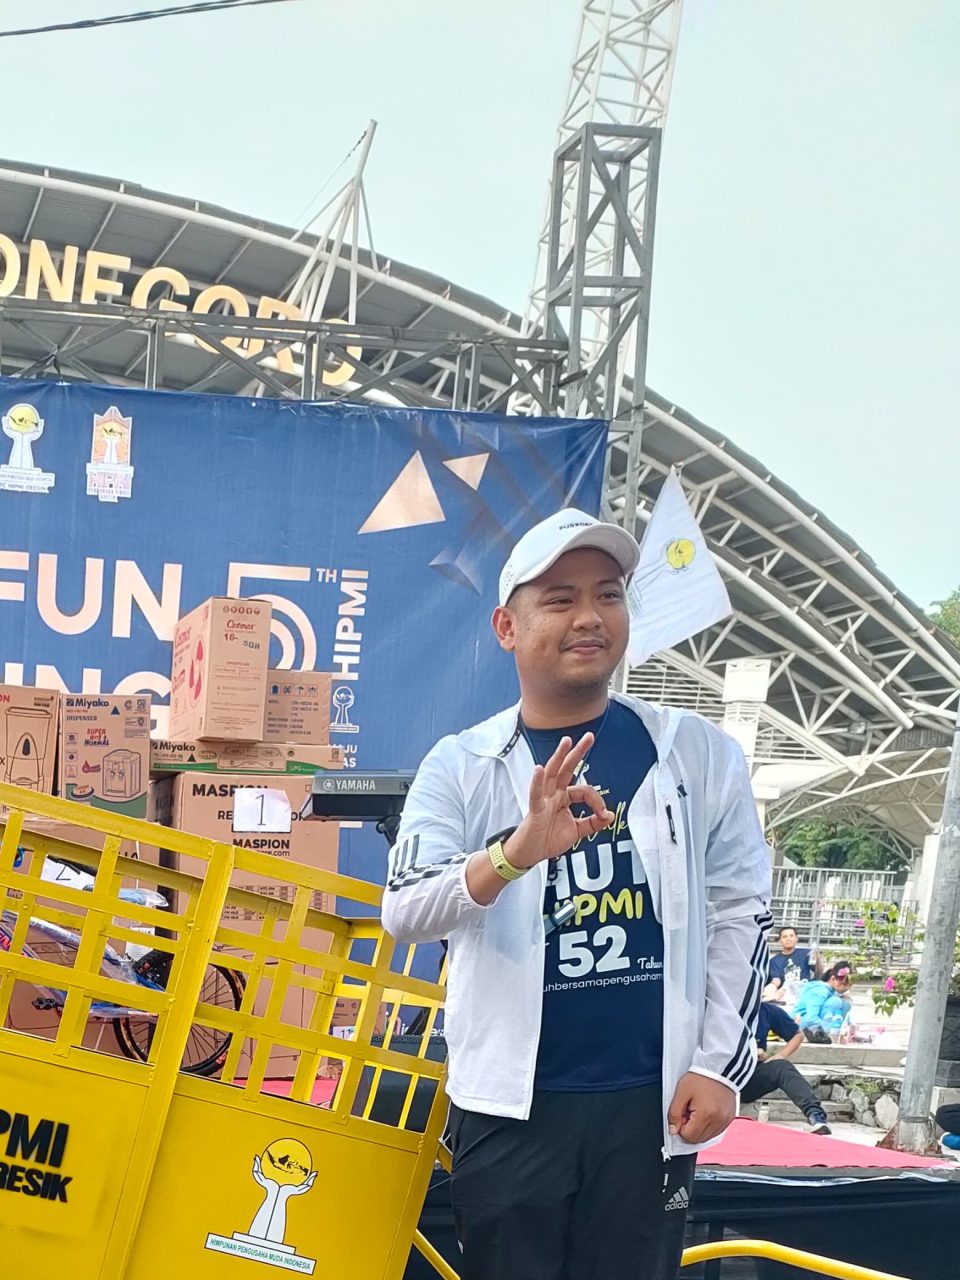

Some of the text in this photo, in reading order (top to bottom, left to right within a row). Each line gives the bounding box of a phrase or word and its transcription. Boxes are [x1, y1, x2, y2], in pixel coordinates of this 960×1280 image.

[331, 568, 369, 681] HIPMI
[74, 698, 110, 709] Miyako
[159, 741, 196, 752] Miyako
[335, 780, 376, 791] YAMAHA
[255, 793, 267, 826] 1
[232, 839, 290, 849] MASPION
[558, 925, 631, 978] 52
[664, 1201, 689, 1211] adida
[209, 1238, 311, 1271] HIMPUNAN PENGUSAHA MUDA INDONESIA
